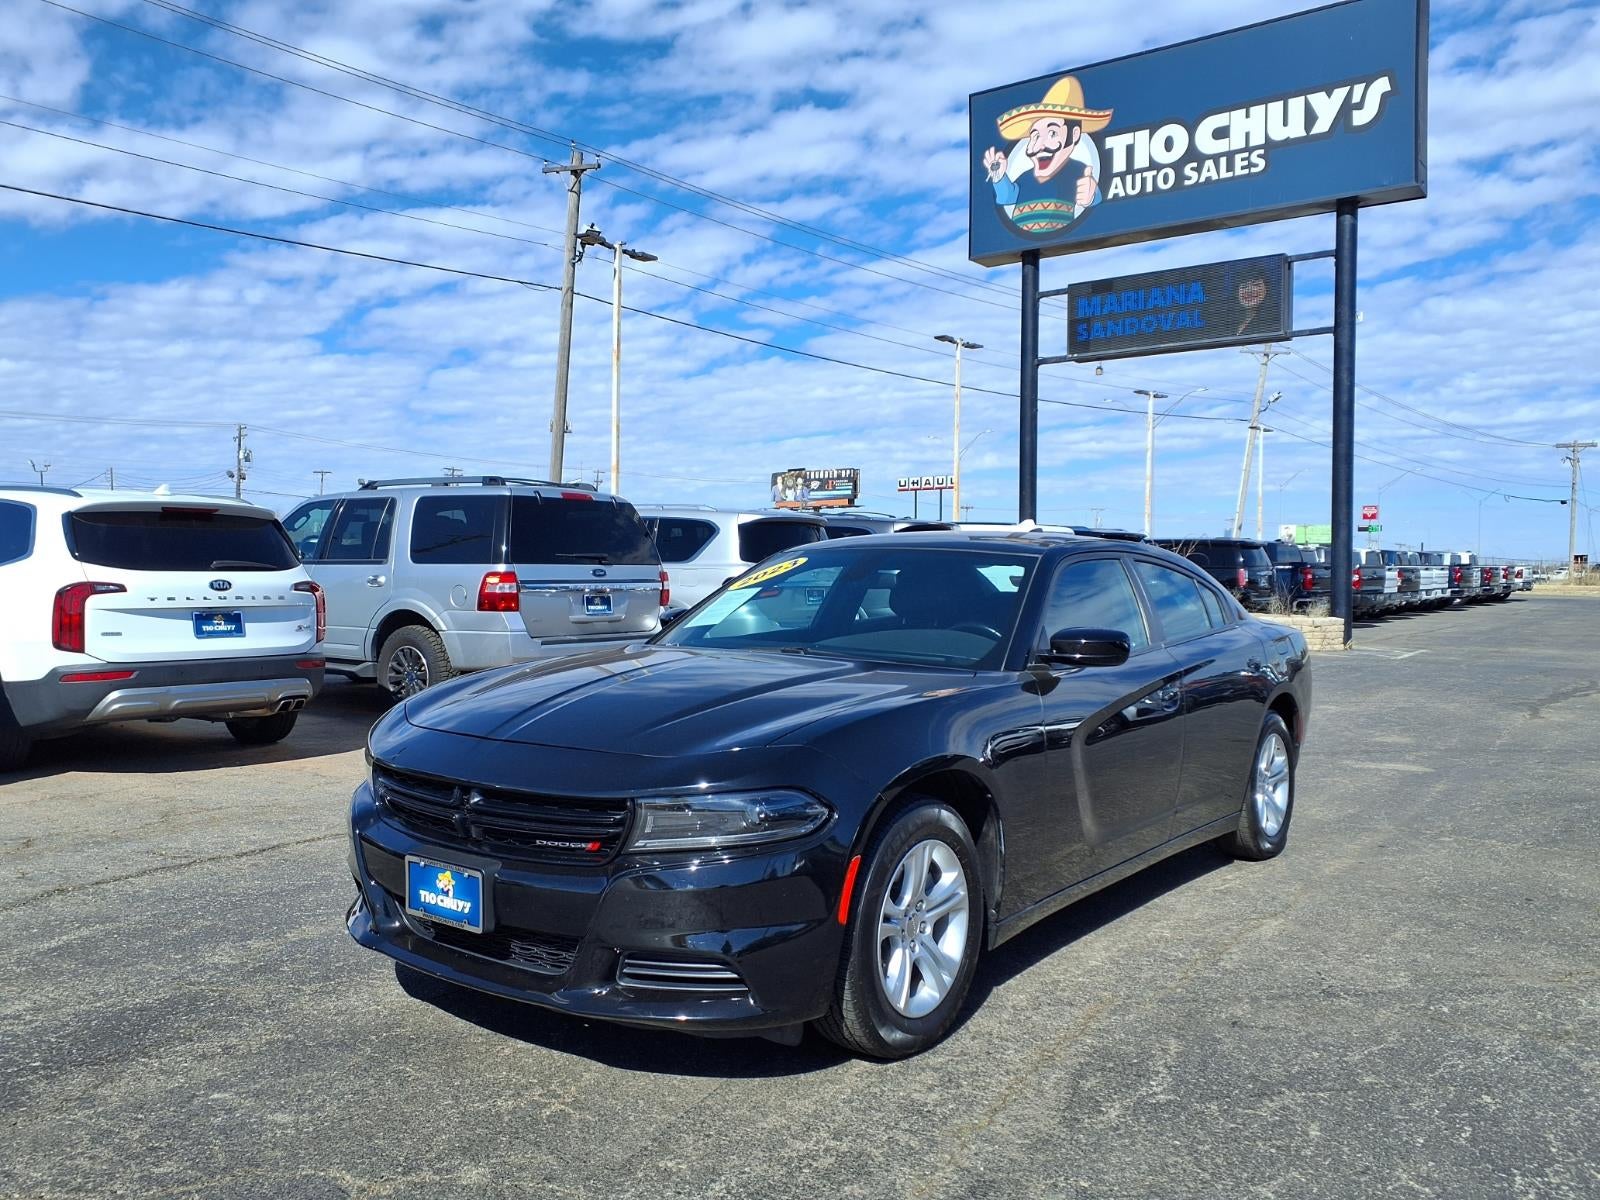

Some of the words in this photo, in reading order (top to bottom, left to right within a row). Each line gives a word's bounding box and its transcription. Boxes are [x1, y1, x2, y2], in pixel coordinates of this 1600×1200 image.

[1105, 123, 1189, 173] TIO
[1194, 76, 1391, 155] CHUY'S
[1107, 167, 1176, 199] AUTO
[1184, 149, 1266, 186] SALES
[1078, 281, 1206, 318] MARIANA
[1077, 310, 1205, 341] SANDOVAL
[211, 580, 230, 590] KIA
[736, 559, 799, 587] 2023
[536, 839, 590, 849] DODGE
[419, 889, 436, 905] TIO
[437, 895, 471, 914] CHUY'S
